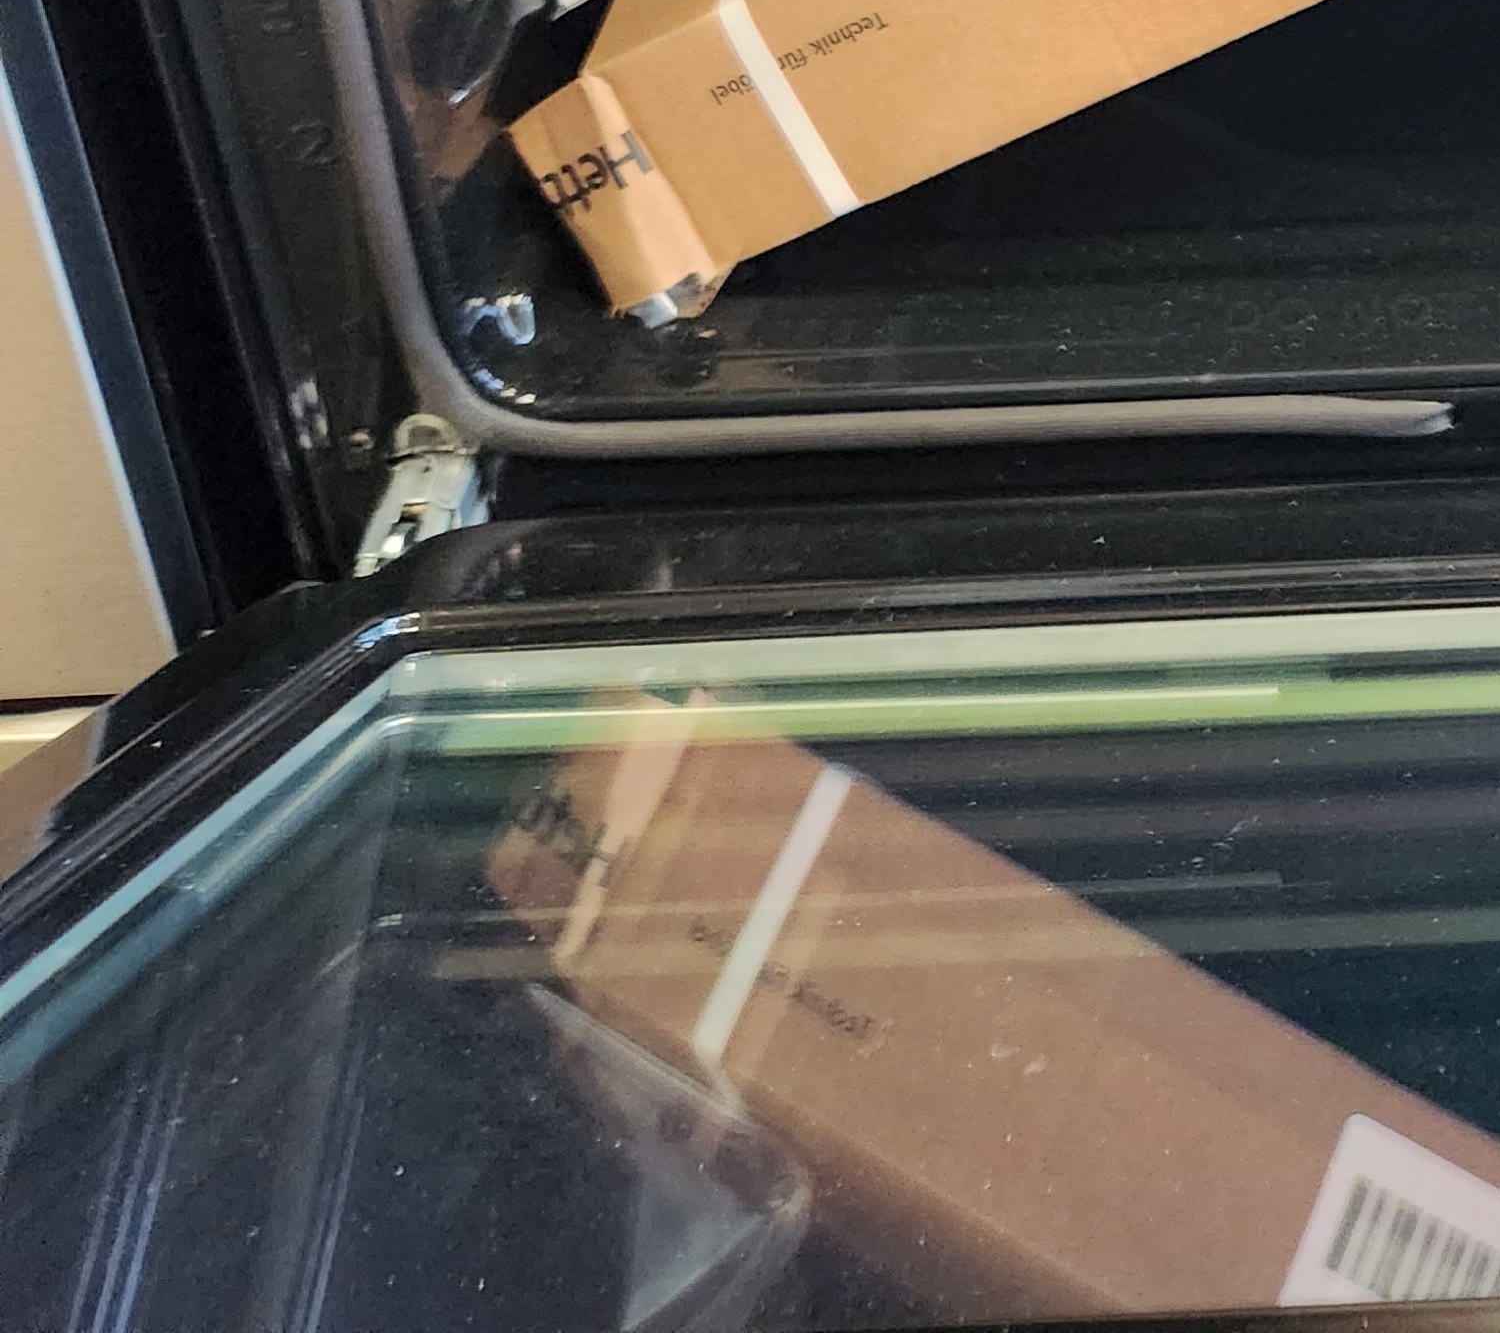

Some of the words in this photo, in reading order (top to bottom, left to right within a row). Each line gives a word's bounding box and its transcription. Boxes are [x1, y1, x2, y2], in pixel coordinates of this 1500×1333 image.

[809, 12, 889, 56] Technik
[777, 48, 809, 71] für
[710, 73, 756, 106] öbel
